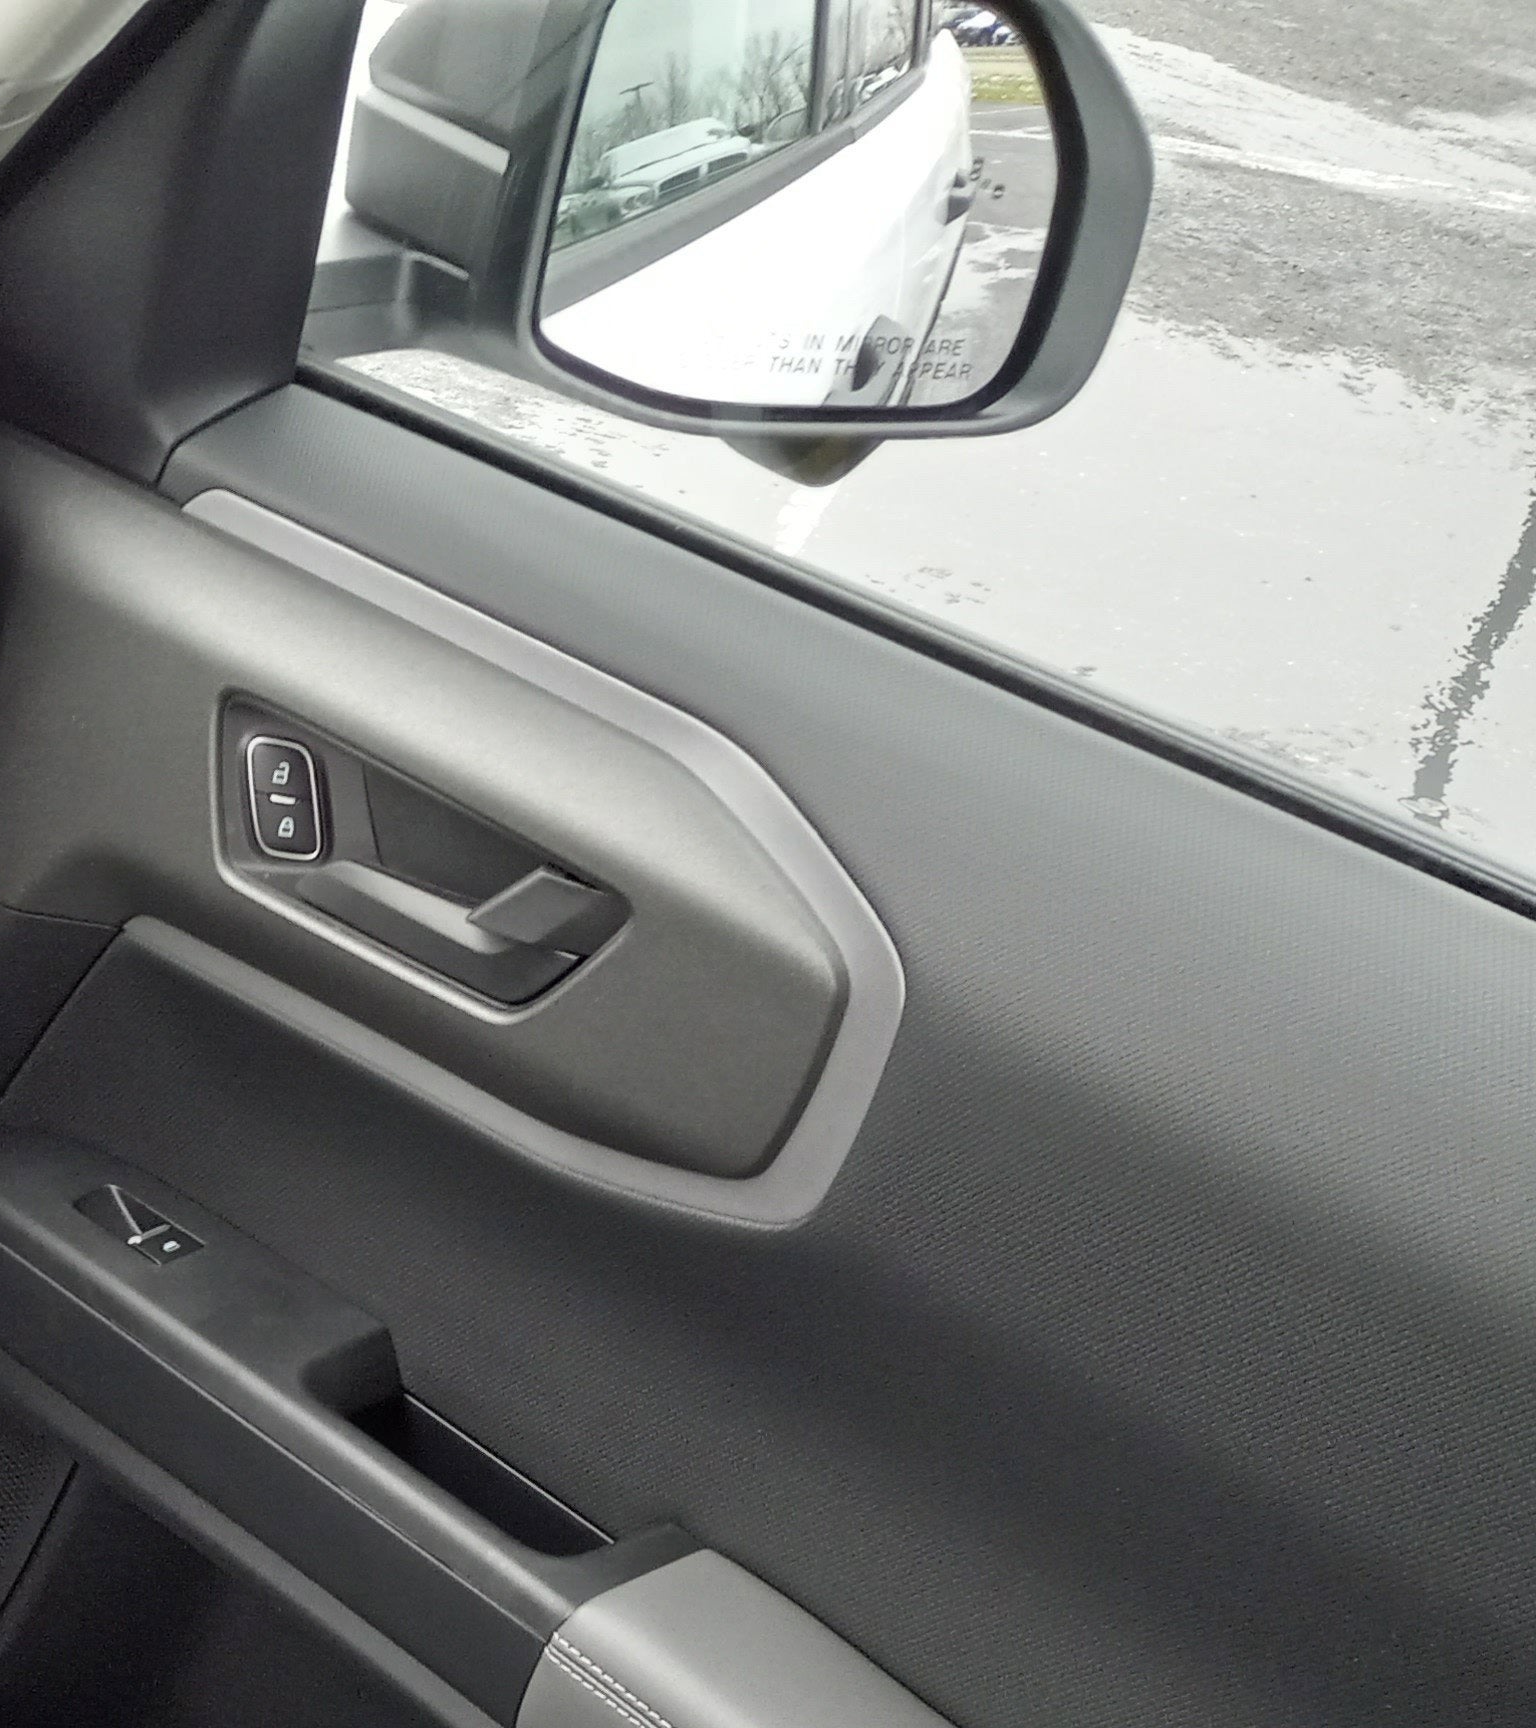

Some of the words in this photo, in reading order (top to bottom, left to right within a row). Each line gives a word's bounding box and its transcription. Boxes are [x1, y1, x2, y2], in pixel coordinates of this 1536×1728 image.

[803, 334, 825, 350] IN
[835, 334, 915, 355] MIROR
[924, 338, 966, 357] ARE
[769, 356, 822, 374] THAN
